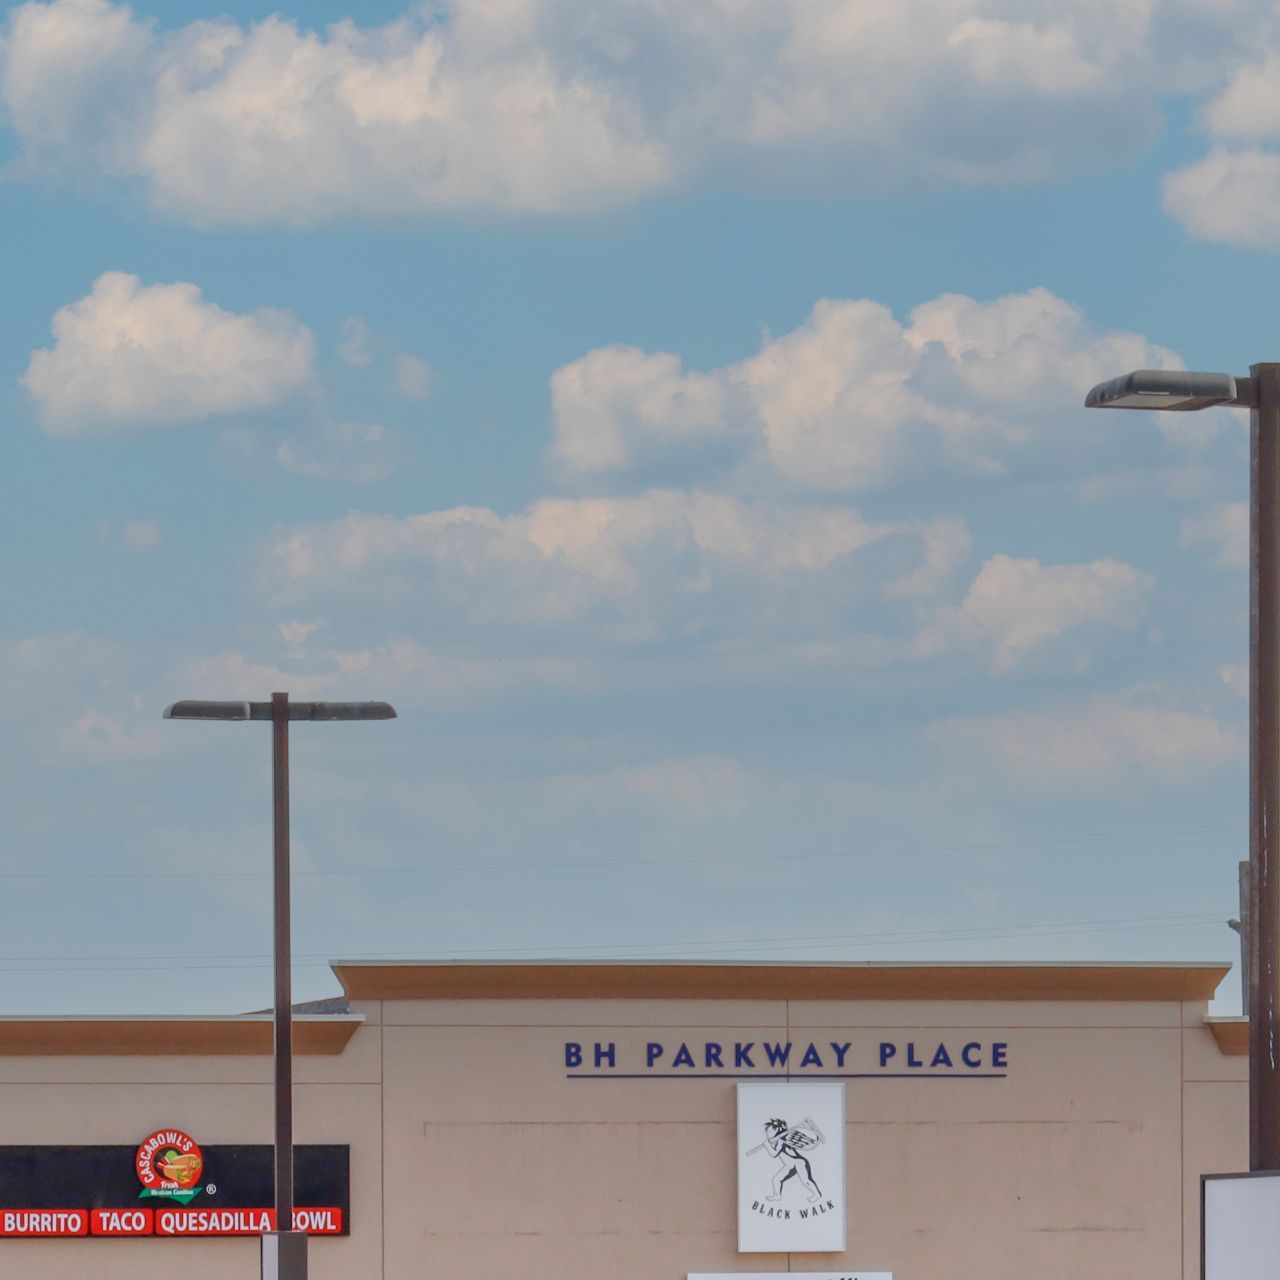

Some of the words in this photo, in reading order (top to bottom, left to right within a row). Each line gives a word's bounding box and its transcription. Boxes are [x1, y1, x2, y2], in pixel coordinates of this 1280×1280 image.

[565, 1042, 616, 1068] BH
[646, 1042, 853, 1068] PARKWAY
[879, 1042, 1009, 1068] PLACE
[138, 1132, 193, 1184] CASCABOWL'S
[751, 1200, 792, 1220] BLACK
[799, 1199, 836, 1220] WALK
[4, 1213, 82, 1233] BURRITO
[99, 1212, 146, 1232] TACO
[160, 1211, 272, 1234] QUESADILLA
[292, 1211, 337, 1231] BOWL
